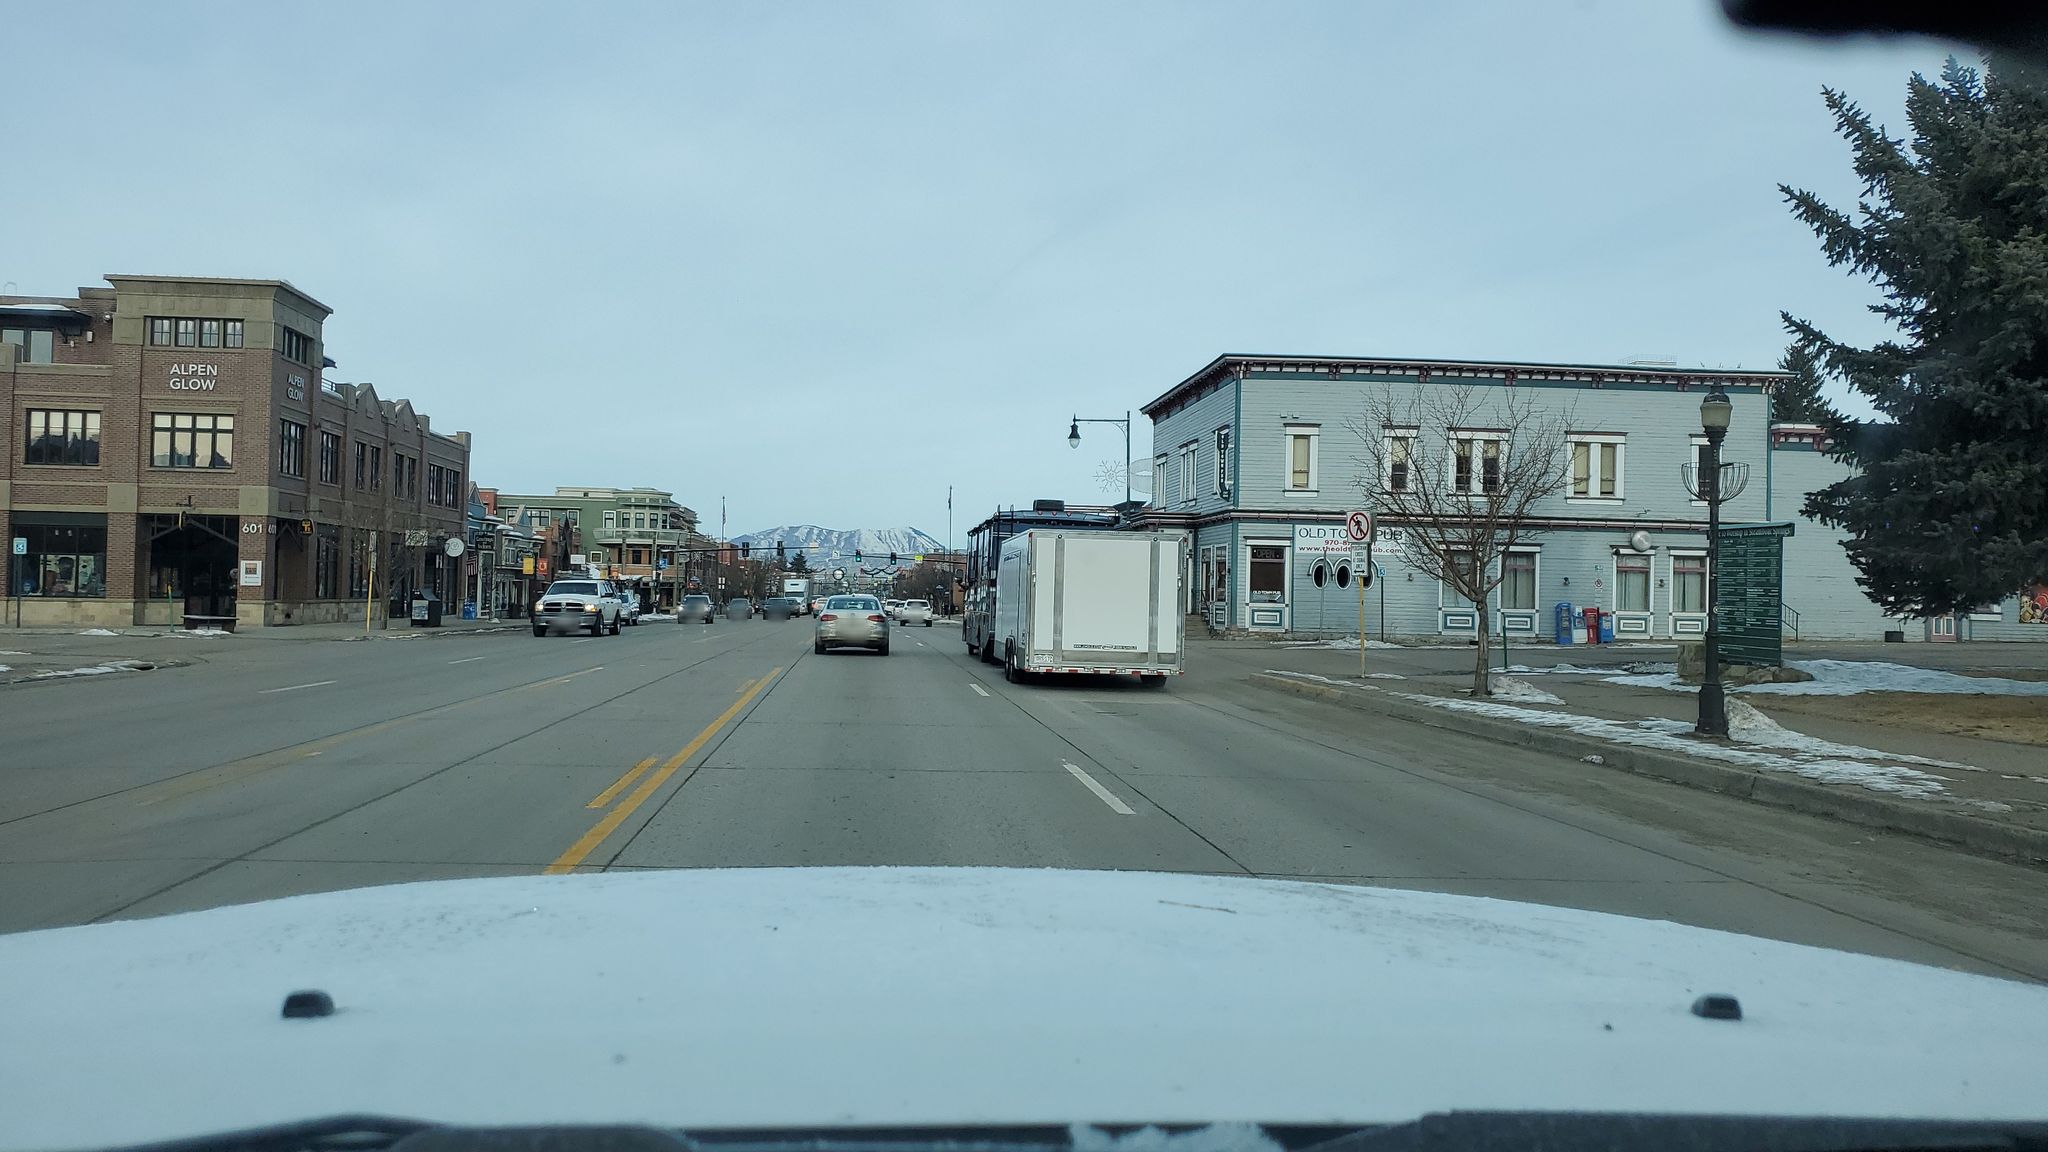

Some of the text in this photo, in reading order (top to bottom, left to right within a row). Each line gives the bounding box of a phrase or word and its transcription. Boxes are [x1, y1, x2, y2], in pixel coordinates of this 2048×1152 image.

[169, 363, 218, 376] ALPEN
[169, 378, 216, 391] GLOW
[287, 373, 305, 388] ALPEN
[287, 388, 304, 401] GLOW
[242, 523, 264, 534] 601
[1298, 528, 1326, 539] OLD
[1377, 529, 1403, 541] PUB
